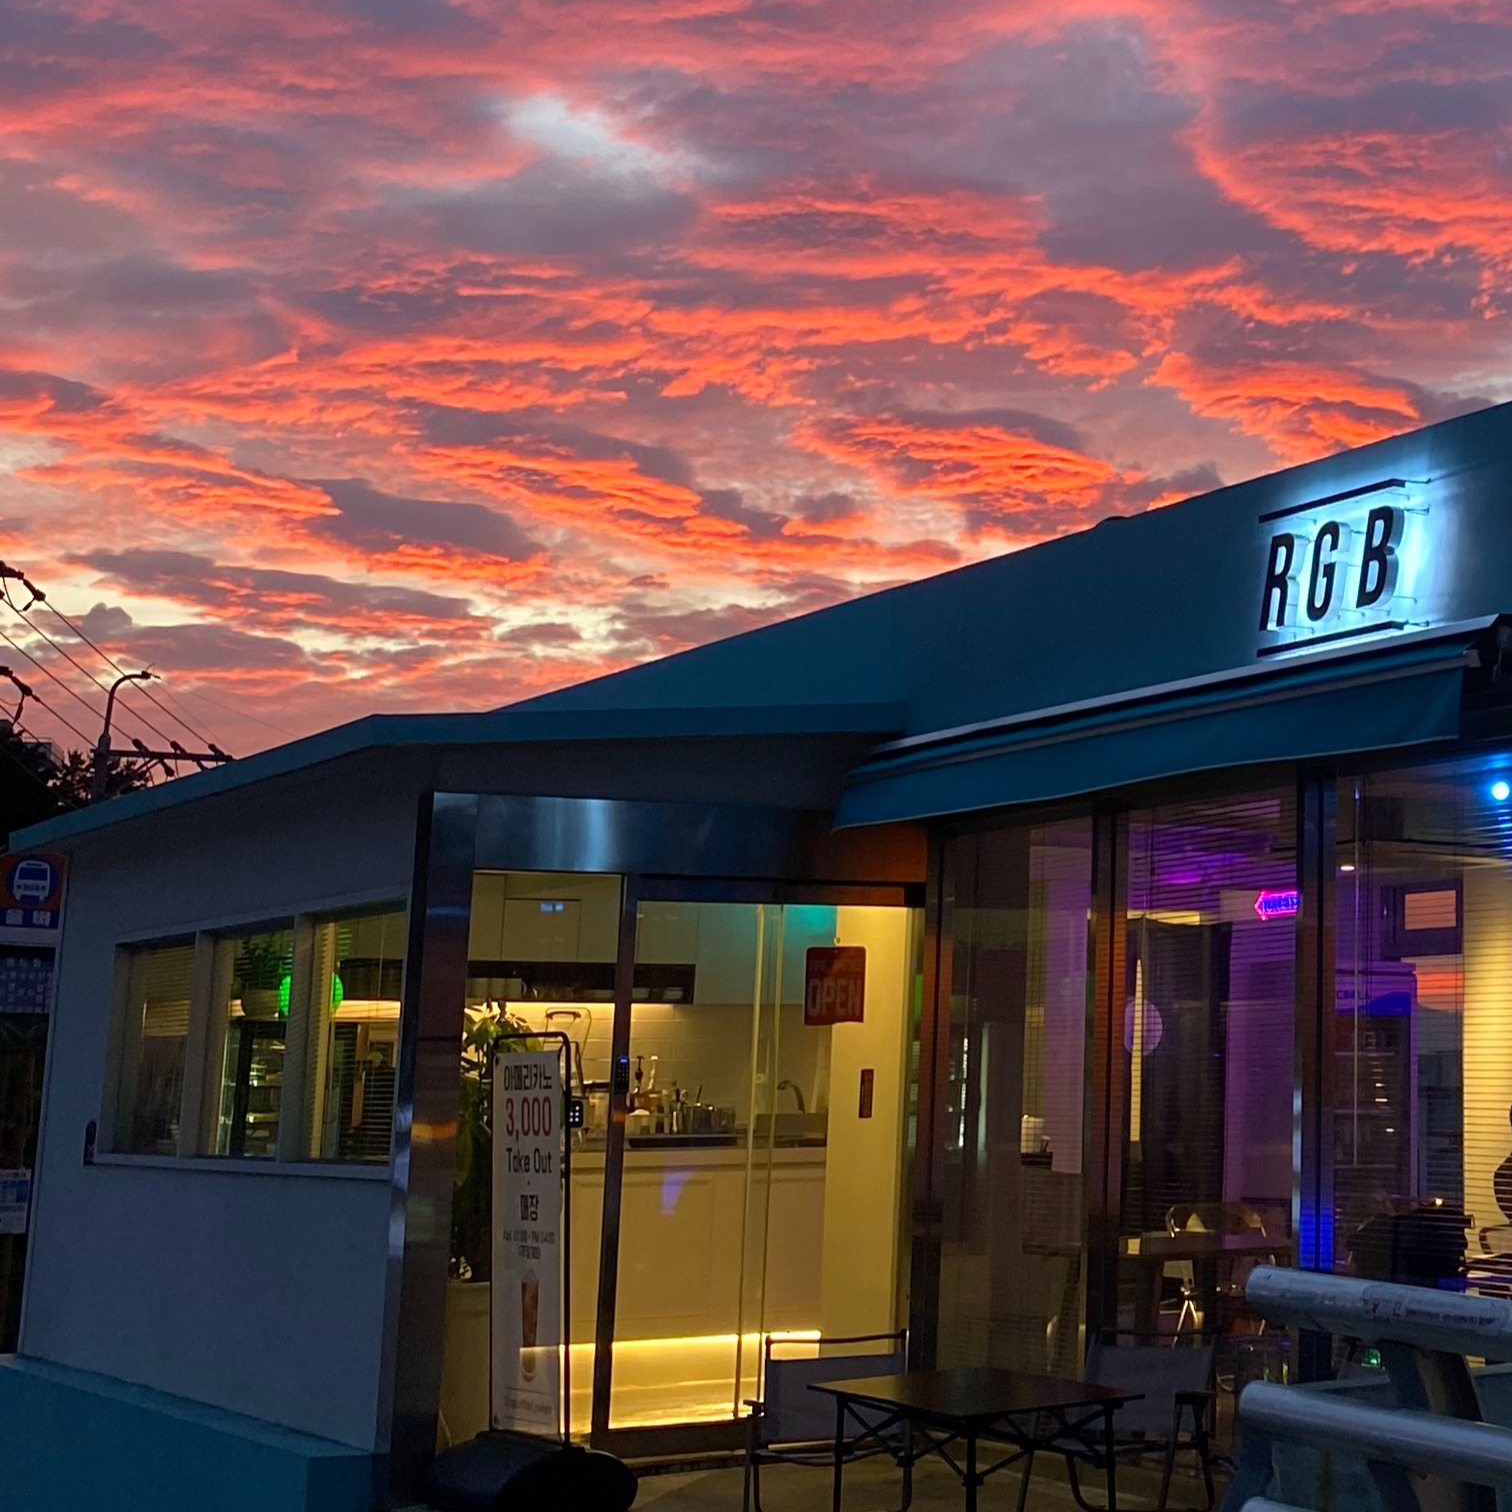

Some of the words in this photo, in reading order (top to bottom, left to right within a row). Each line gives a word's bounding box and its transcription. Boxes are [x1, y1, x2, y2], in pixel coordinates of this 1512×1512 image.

[1258, 505, 1404, 631] RGB
[807, 978, 862, 1016] OPEN
[503, 1062, 553, 1091] 아메리카노
[505, 1096, 552, 1142] 3,000
[506, 1147, 531, 1174] Take
[533, 1147, 552, 1174] Out
